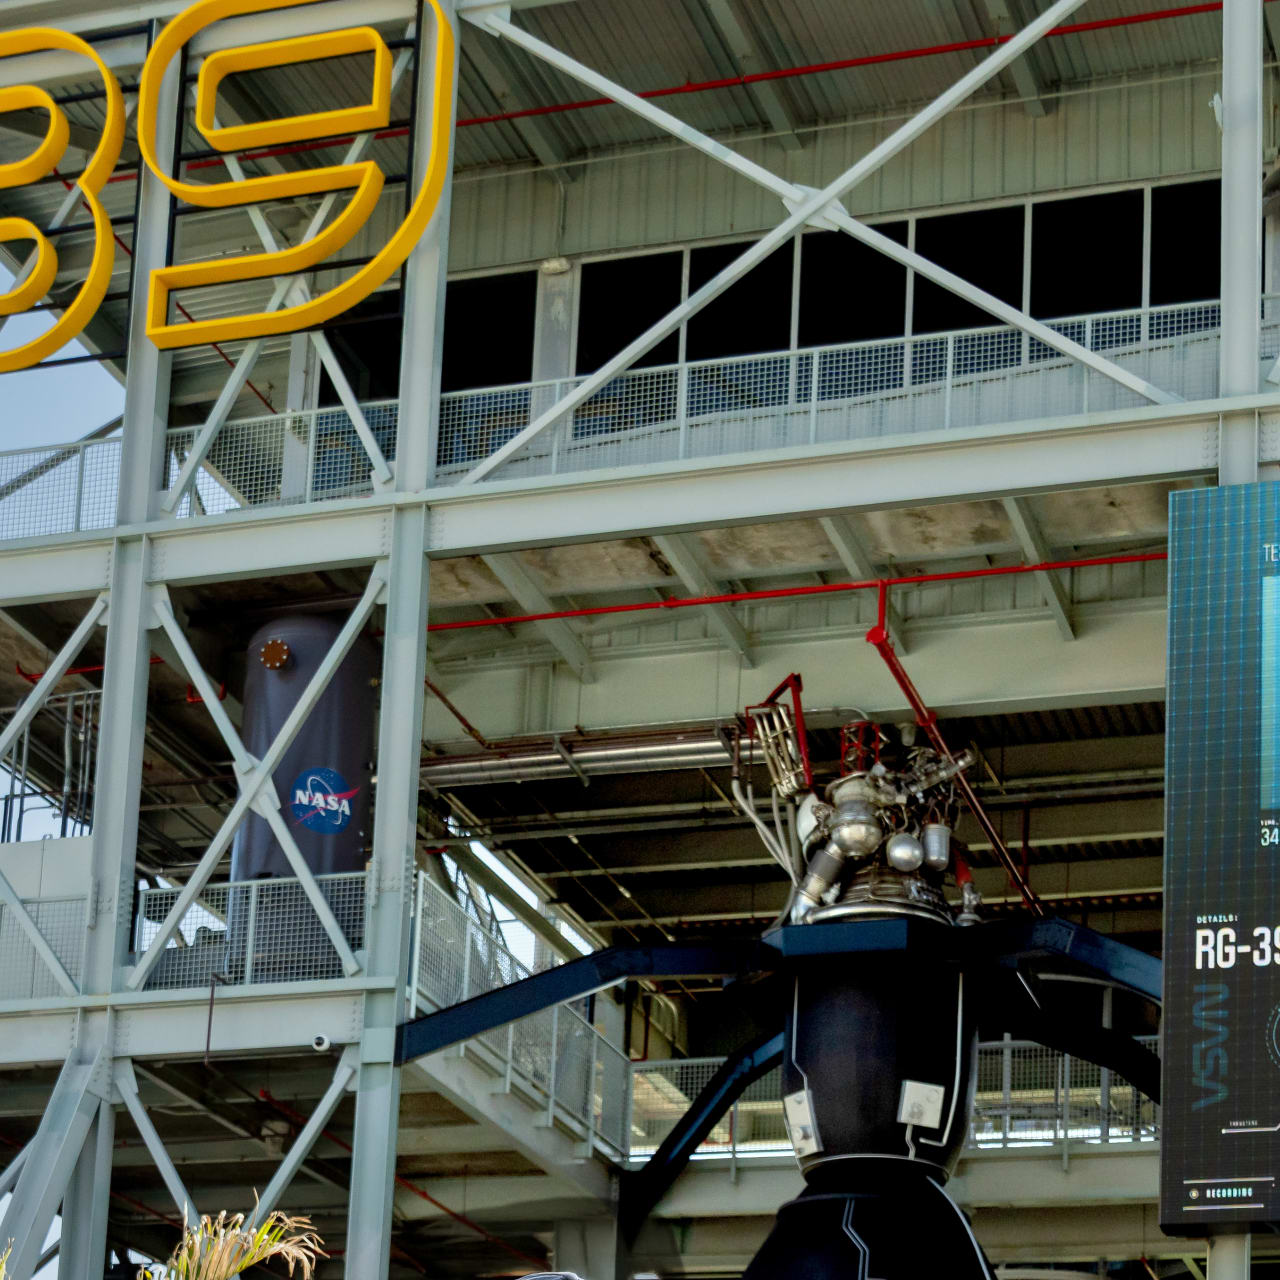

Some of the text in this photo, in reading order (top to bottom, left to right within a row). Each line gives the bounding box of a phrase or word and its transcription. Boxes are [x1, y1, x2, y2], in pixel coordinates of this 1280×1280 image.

[295, 789, 351, 816] NASA
[1197, 914, 1238, 924] DETAILS:
[1205, 1187, 1253, 1199] RECORDING
